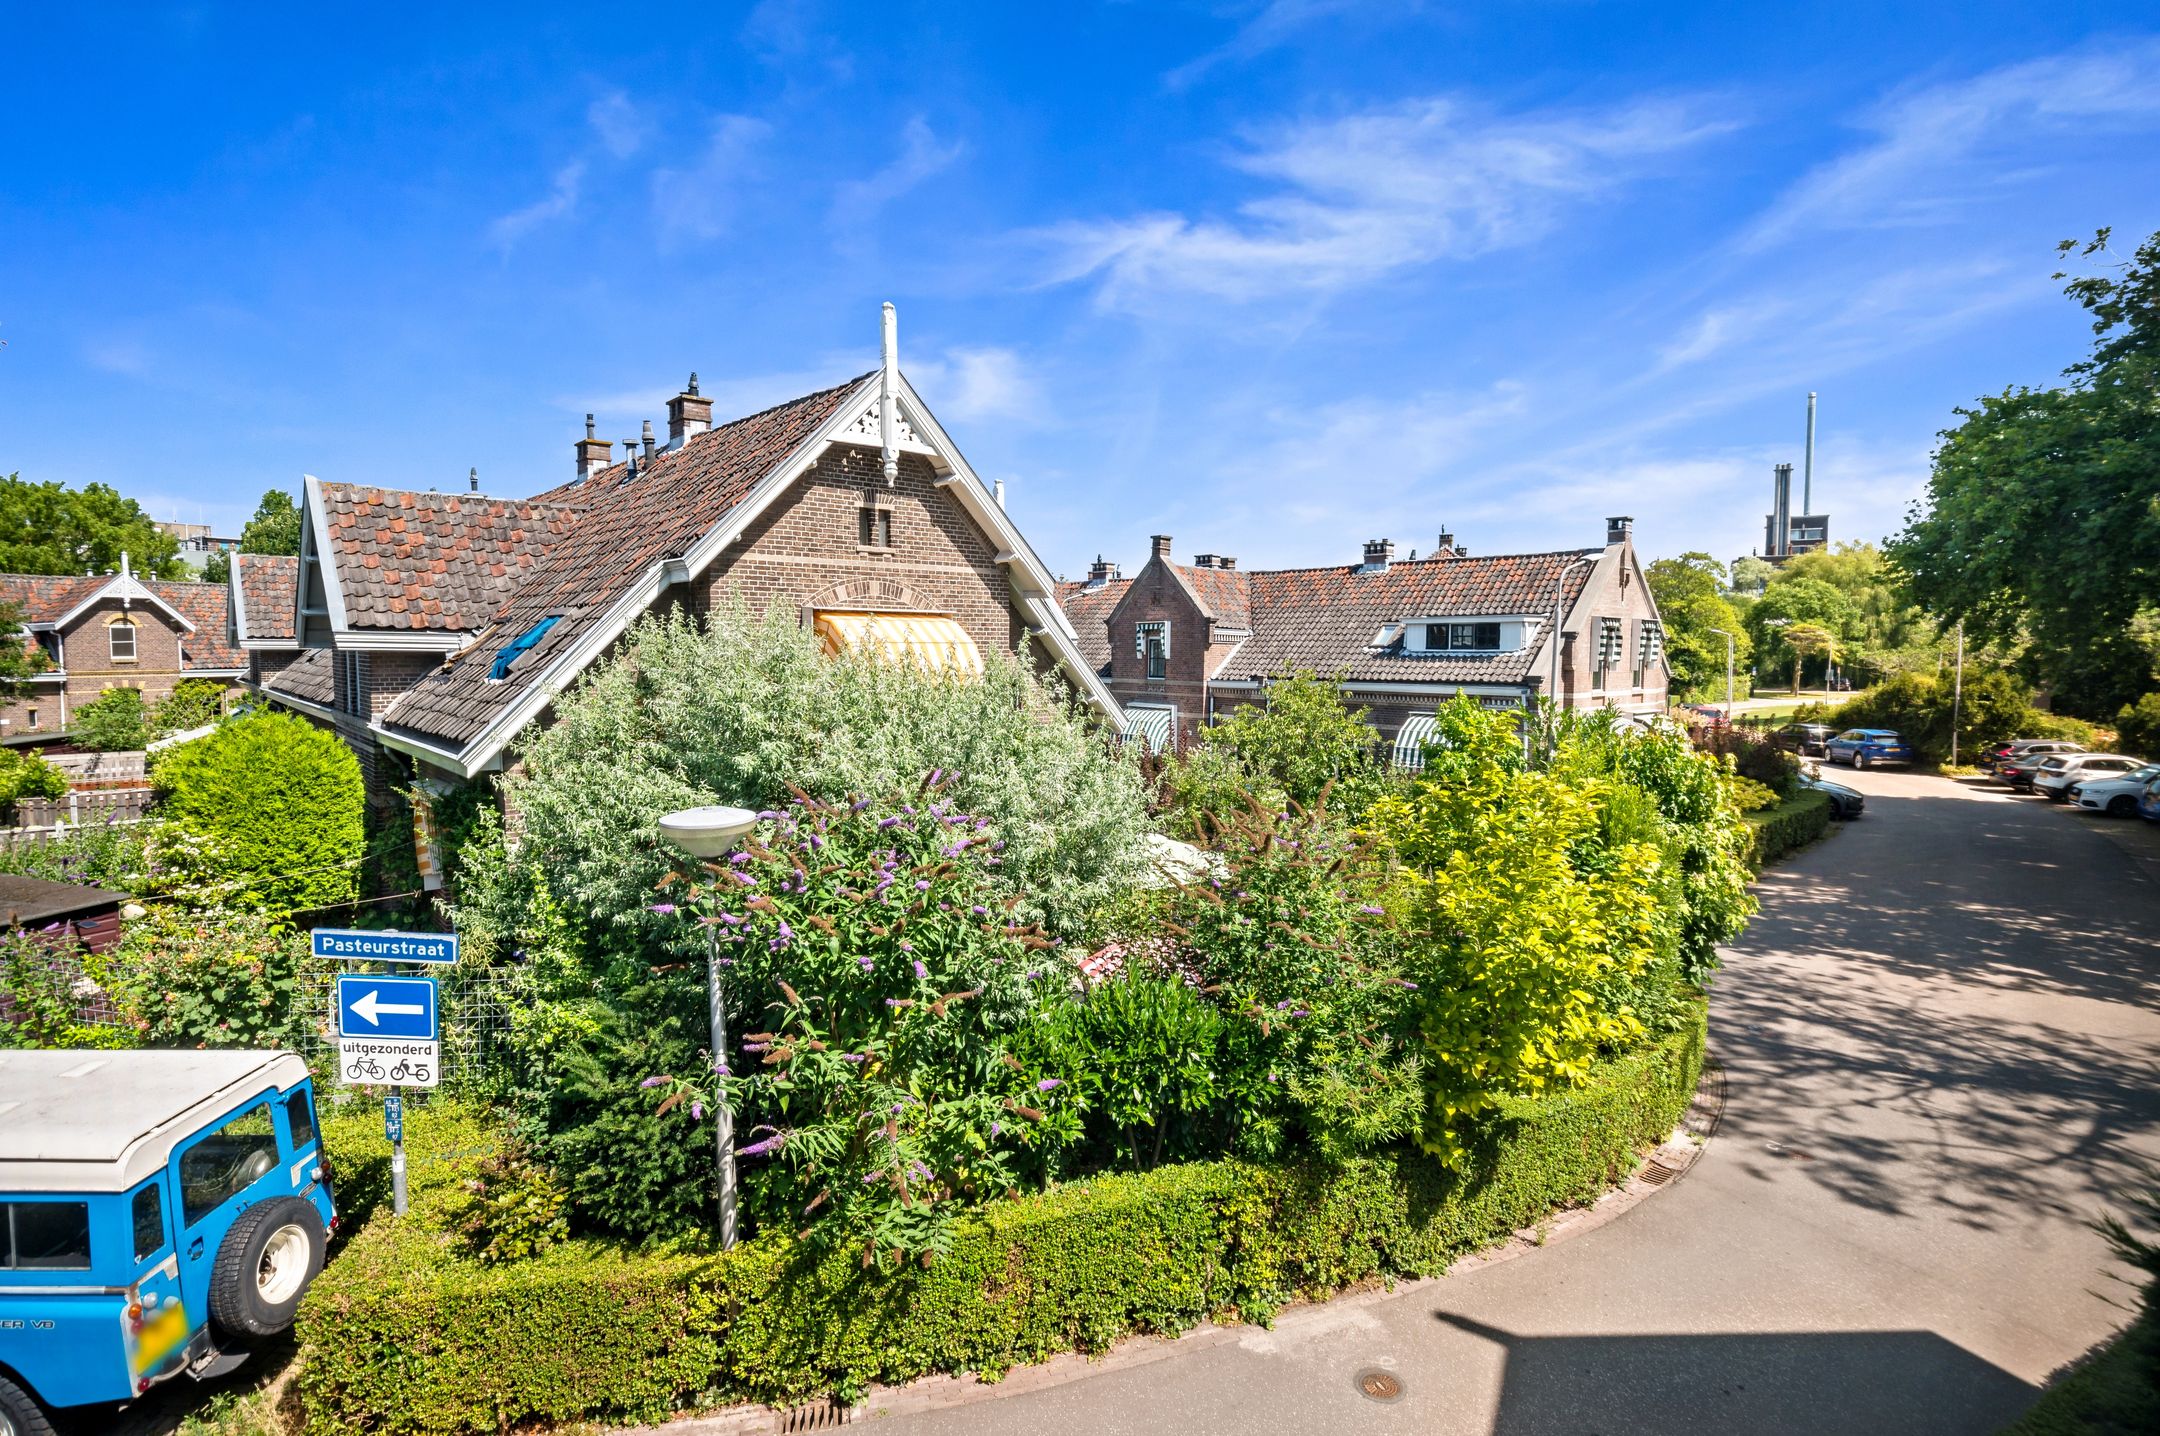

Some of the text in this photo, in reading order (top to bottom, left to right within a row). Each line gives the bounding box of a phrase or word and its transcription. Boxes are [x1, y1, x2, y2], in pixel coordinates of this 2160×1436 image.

[322, 937, 445, 956] Pasteurstraat
[343, 1042, 432, 1056] uitgezonderd
[0, 1319, 55, 1329] ER V8
